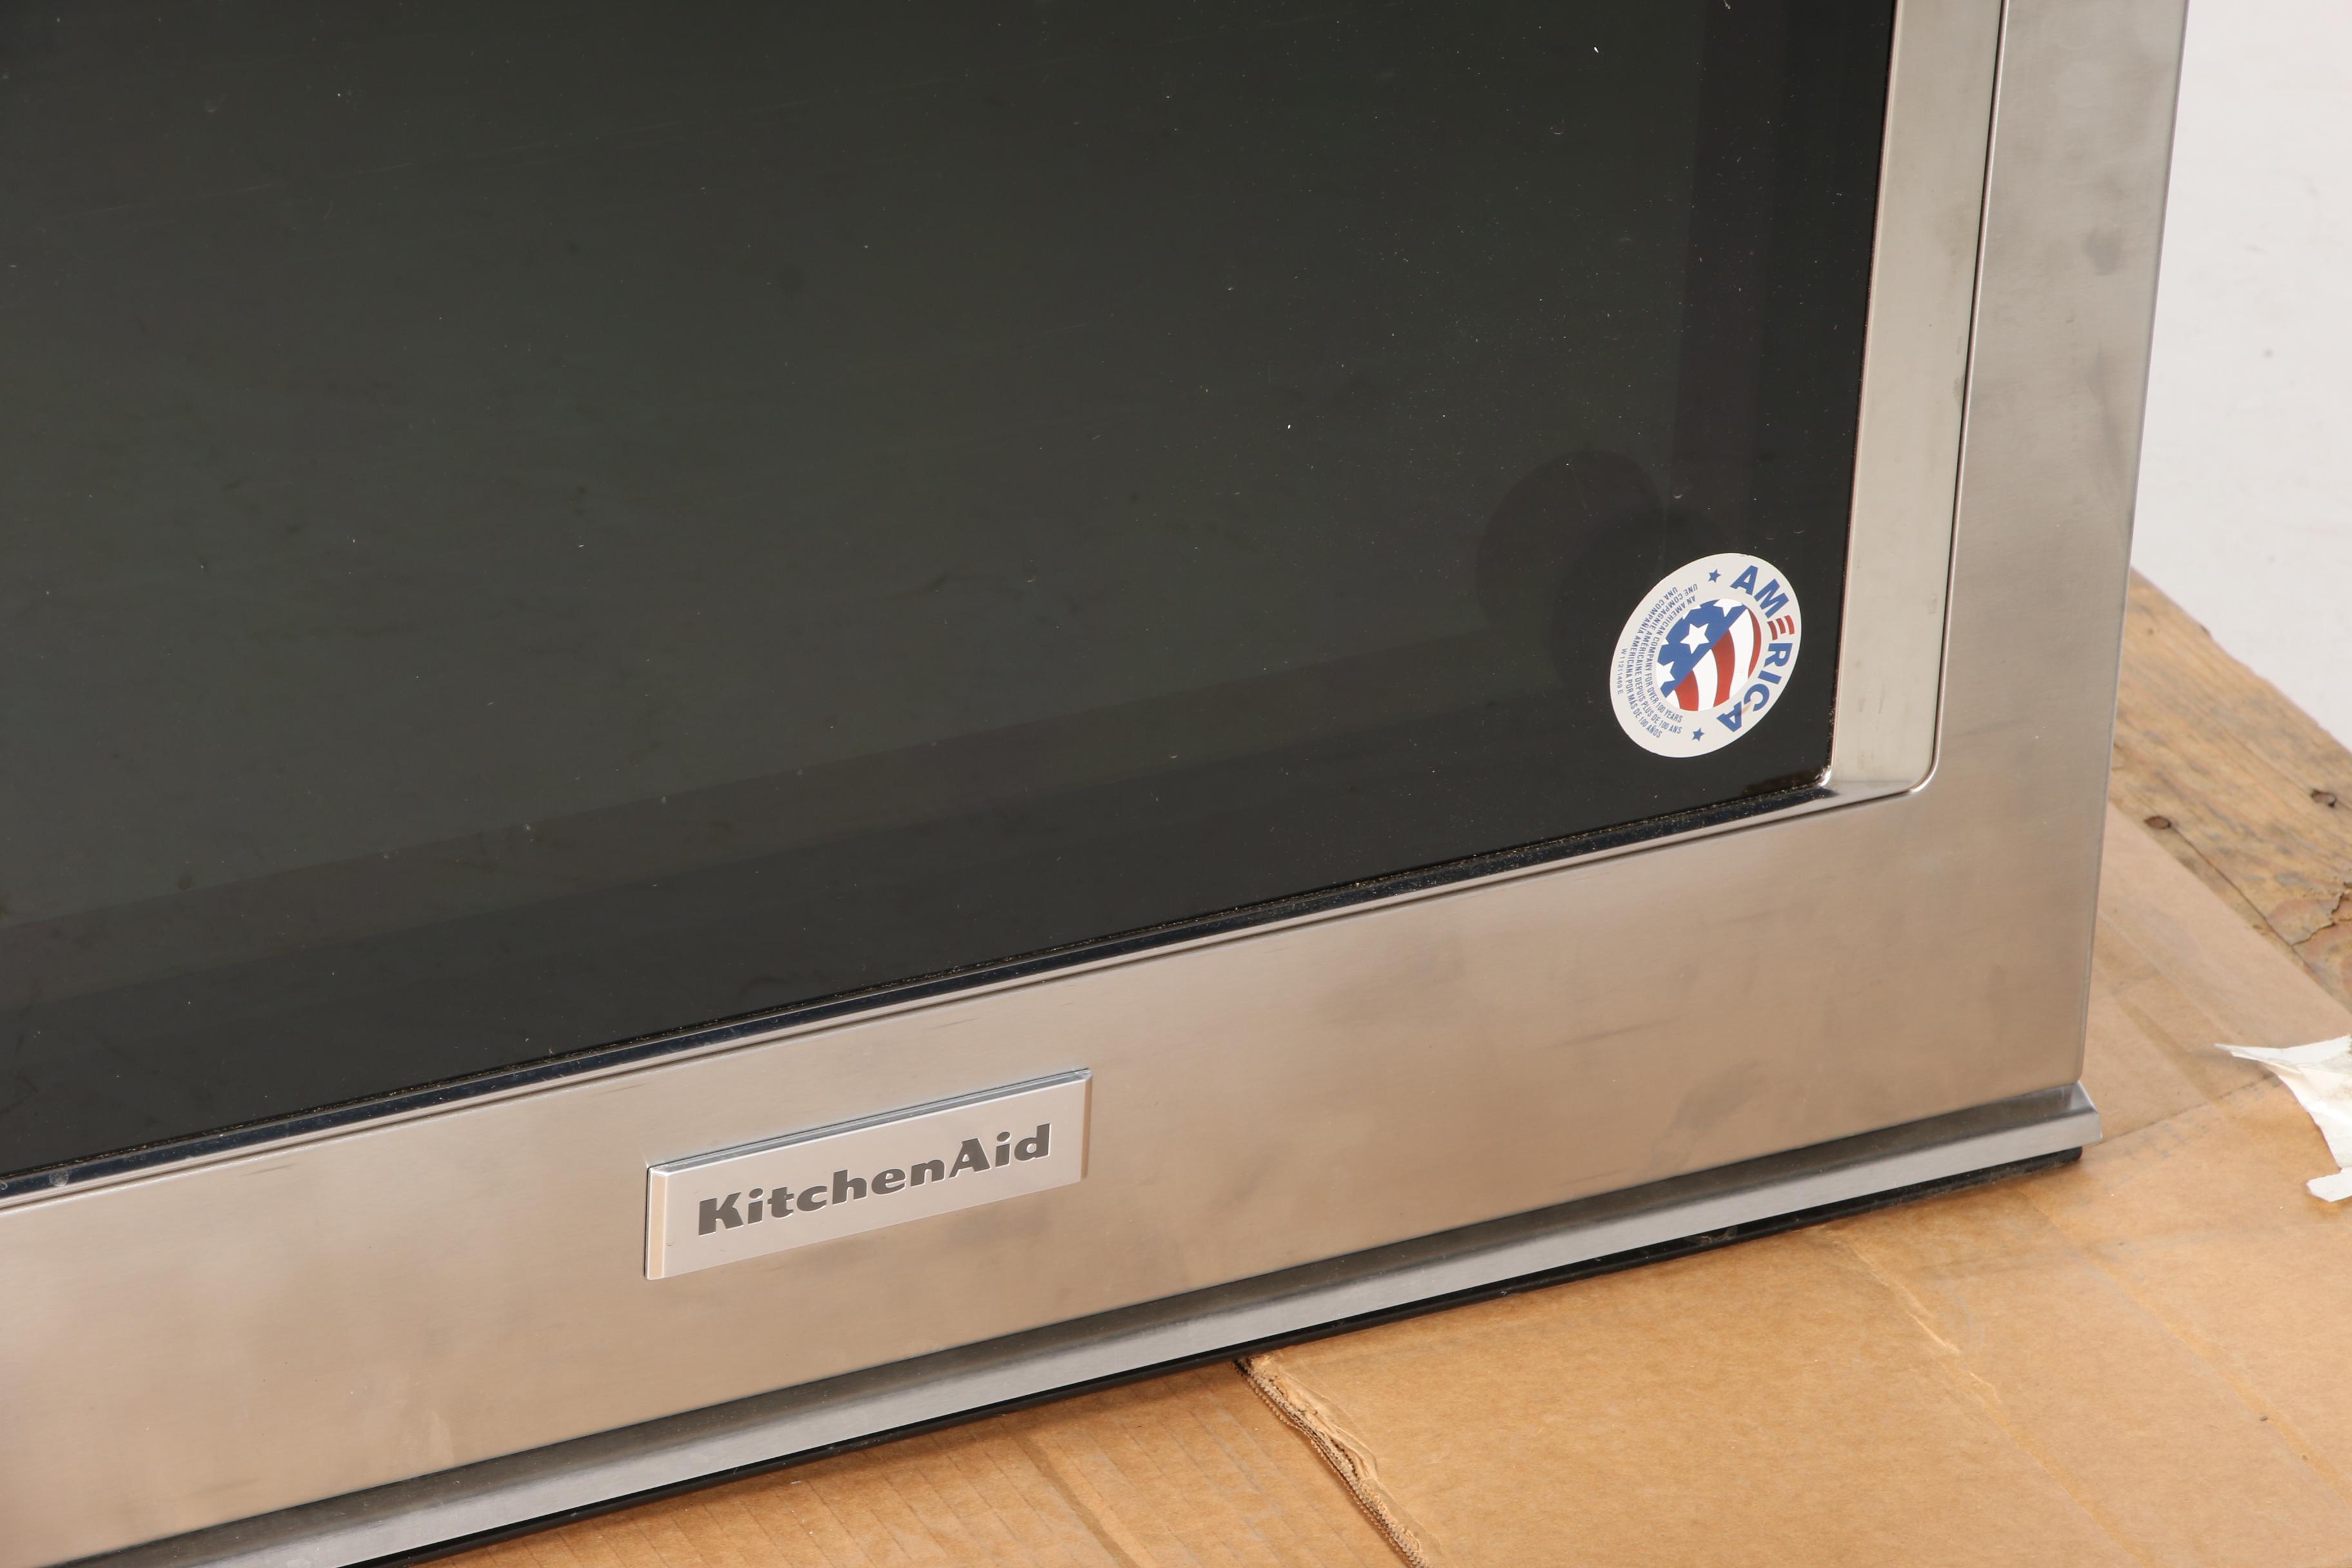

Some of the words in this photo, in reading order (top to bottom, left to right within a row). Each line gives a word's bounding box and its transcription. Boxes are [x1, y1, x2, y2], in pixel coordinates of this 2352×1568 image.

[1663, 587, 1678, 600] UNA
[1683, 583, 1698, 596] UNE
[1687, 595, 1696, 605] AN
[1649, 593, 1683, 631] COMPAGNIE
[1656, 603, 1685, 636] AMERICAN
[1634, 631, 1652, 676] AMÉRICAINE
[1645, 636, 1660, 671] COMPANY
[1716, 565, 1795, 732] AMERICA
[1625, 635, 1641, 678] AMERICANA
[1625, 679, 1634, 694] POR
[1634, 676, 1645, 701] DEPUIS
[1627, 694, 1638, 709] MÁS
[1647, 687, 1659, 703] OVER
[1633, 708, 1642, 718] DE
[1642, 701, 1654, 716] PLUS
[1656, 702, 1666, 712] 100
[1638, 717, 1649, 727] 100
[1651, 714, 1660, 724] DE
[1664, 709, 1683, 723] YEARS
[1646, 724, 1662, 738] AÑOS
[1659, 720, 1669, 730] 100
[1669, 724, 1682, 734] ANS
[698, 1122, 1052, 1237] KitchenAid
